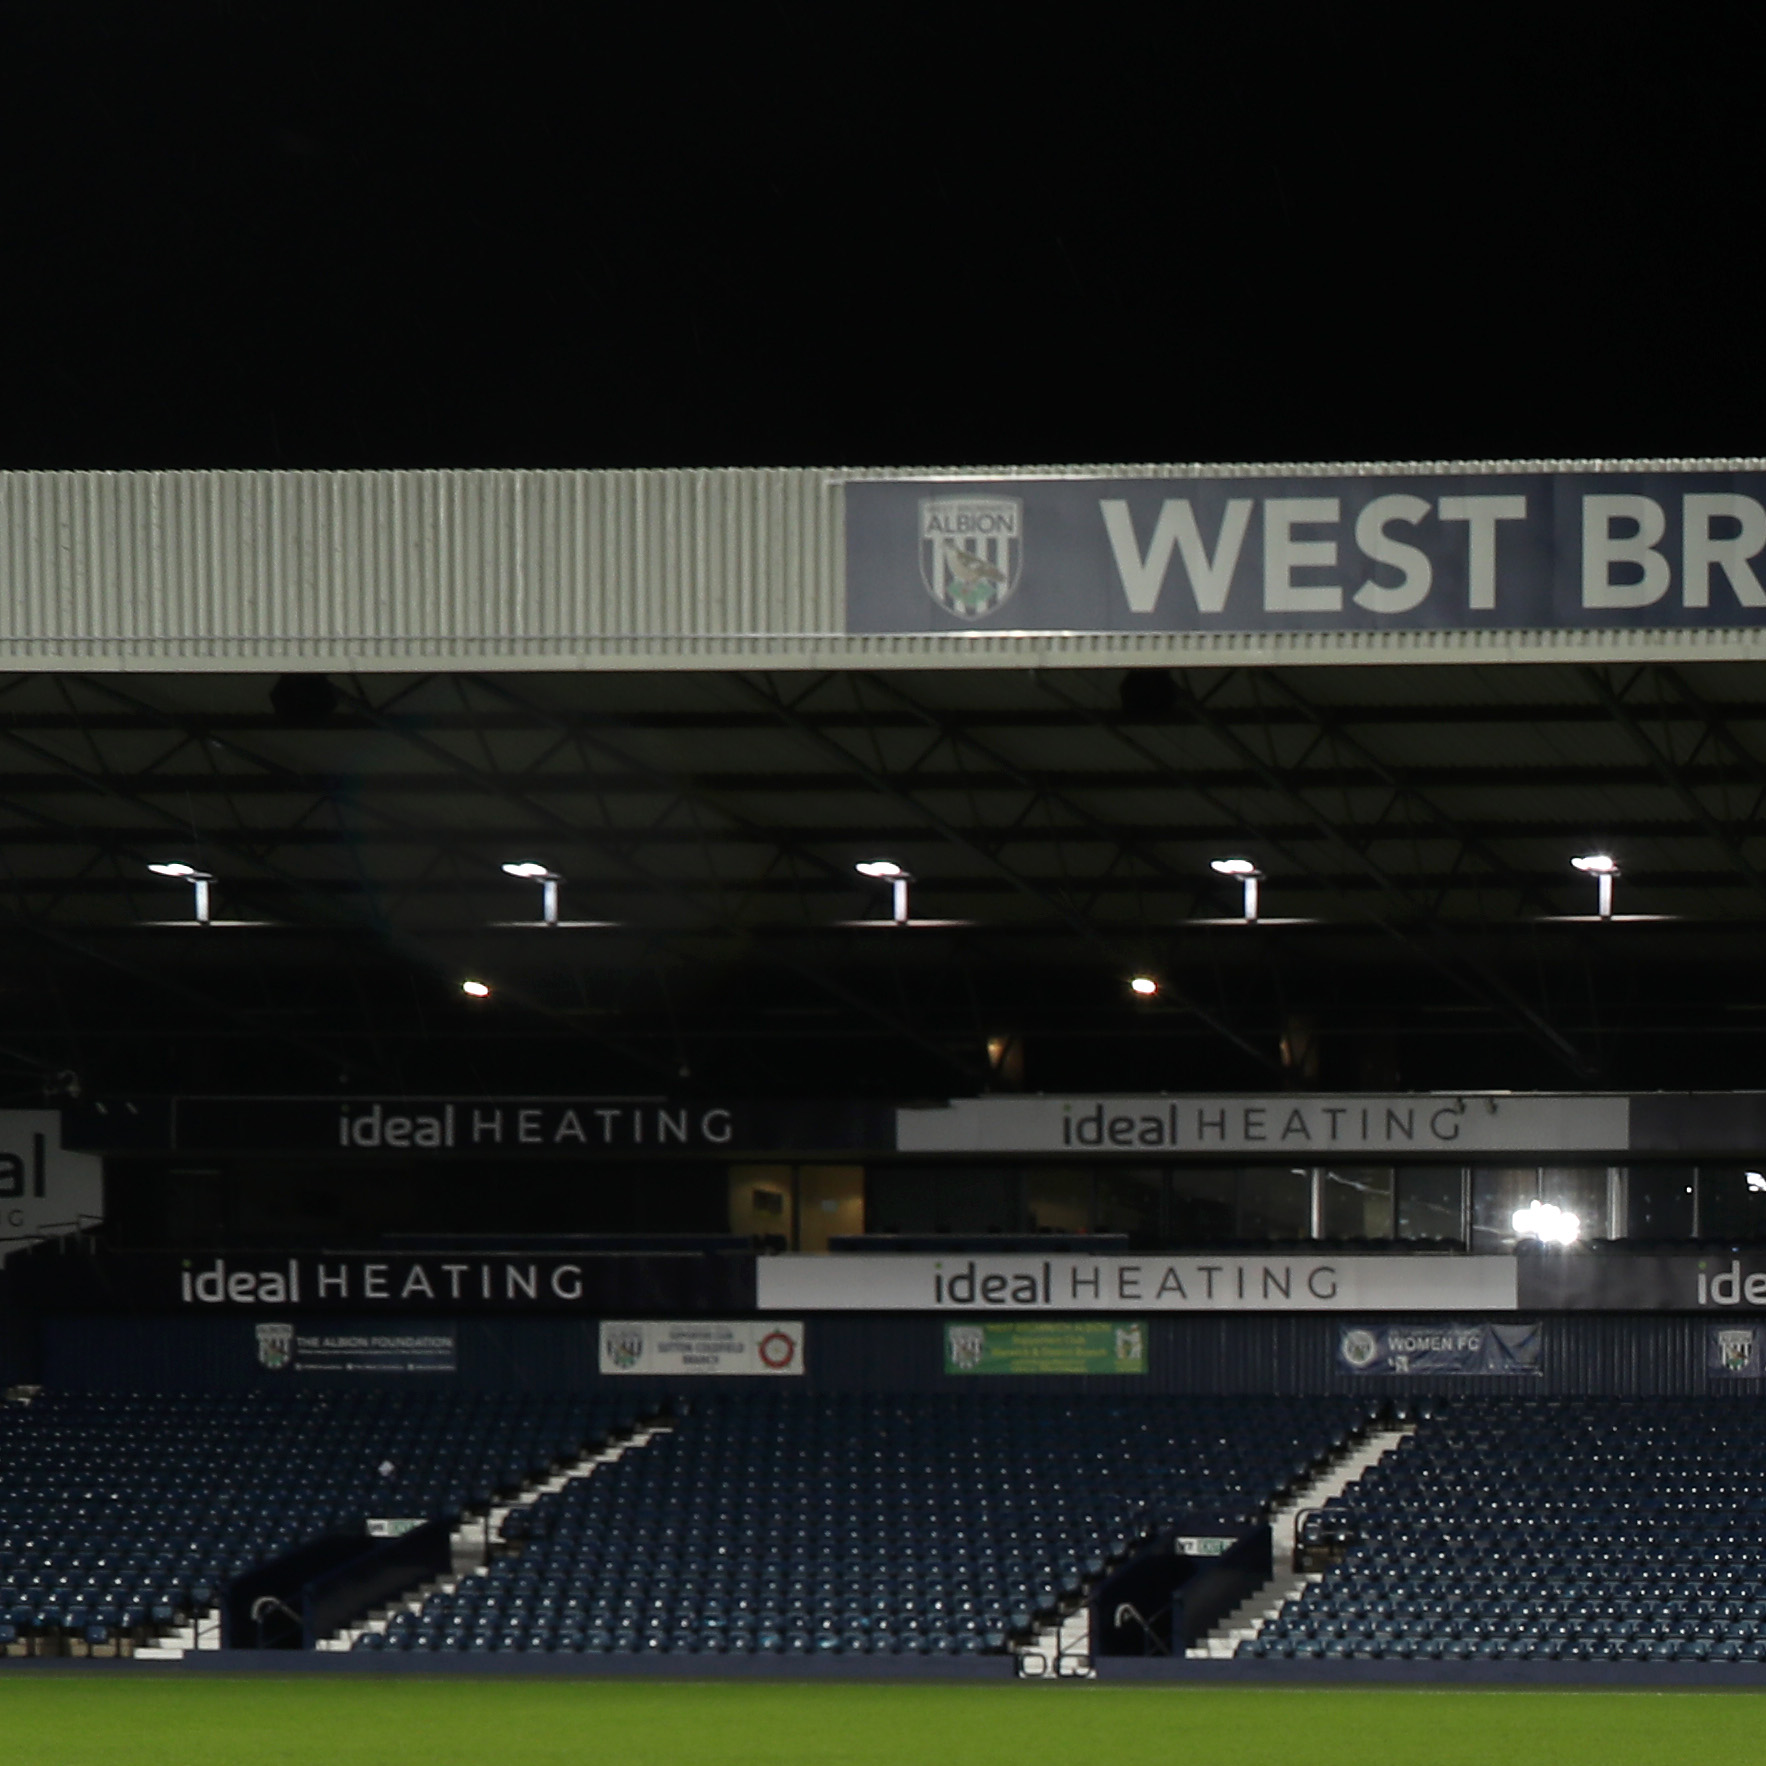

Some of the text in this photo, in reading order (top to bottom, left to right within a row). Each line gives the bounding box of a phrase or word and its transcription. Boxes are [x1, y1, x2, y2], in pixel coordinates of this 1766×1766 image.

[927, 514, 1013, 533] ALBION
[1099, 494, 1529, 612] WEST
[339, 1104, 733, 1146] ideal HEATING
[1062, 1103, 1460, 1147] ideal HEATING
[183, 1259, 583, 1303] ideal HEATING
[934, 1261, 1338, 1305] ideal HEATING
[1389, 1337, 1481, 1351] WOMEN FC
